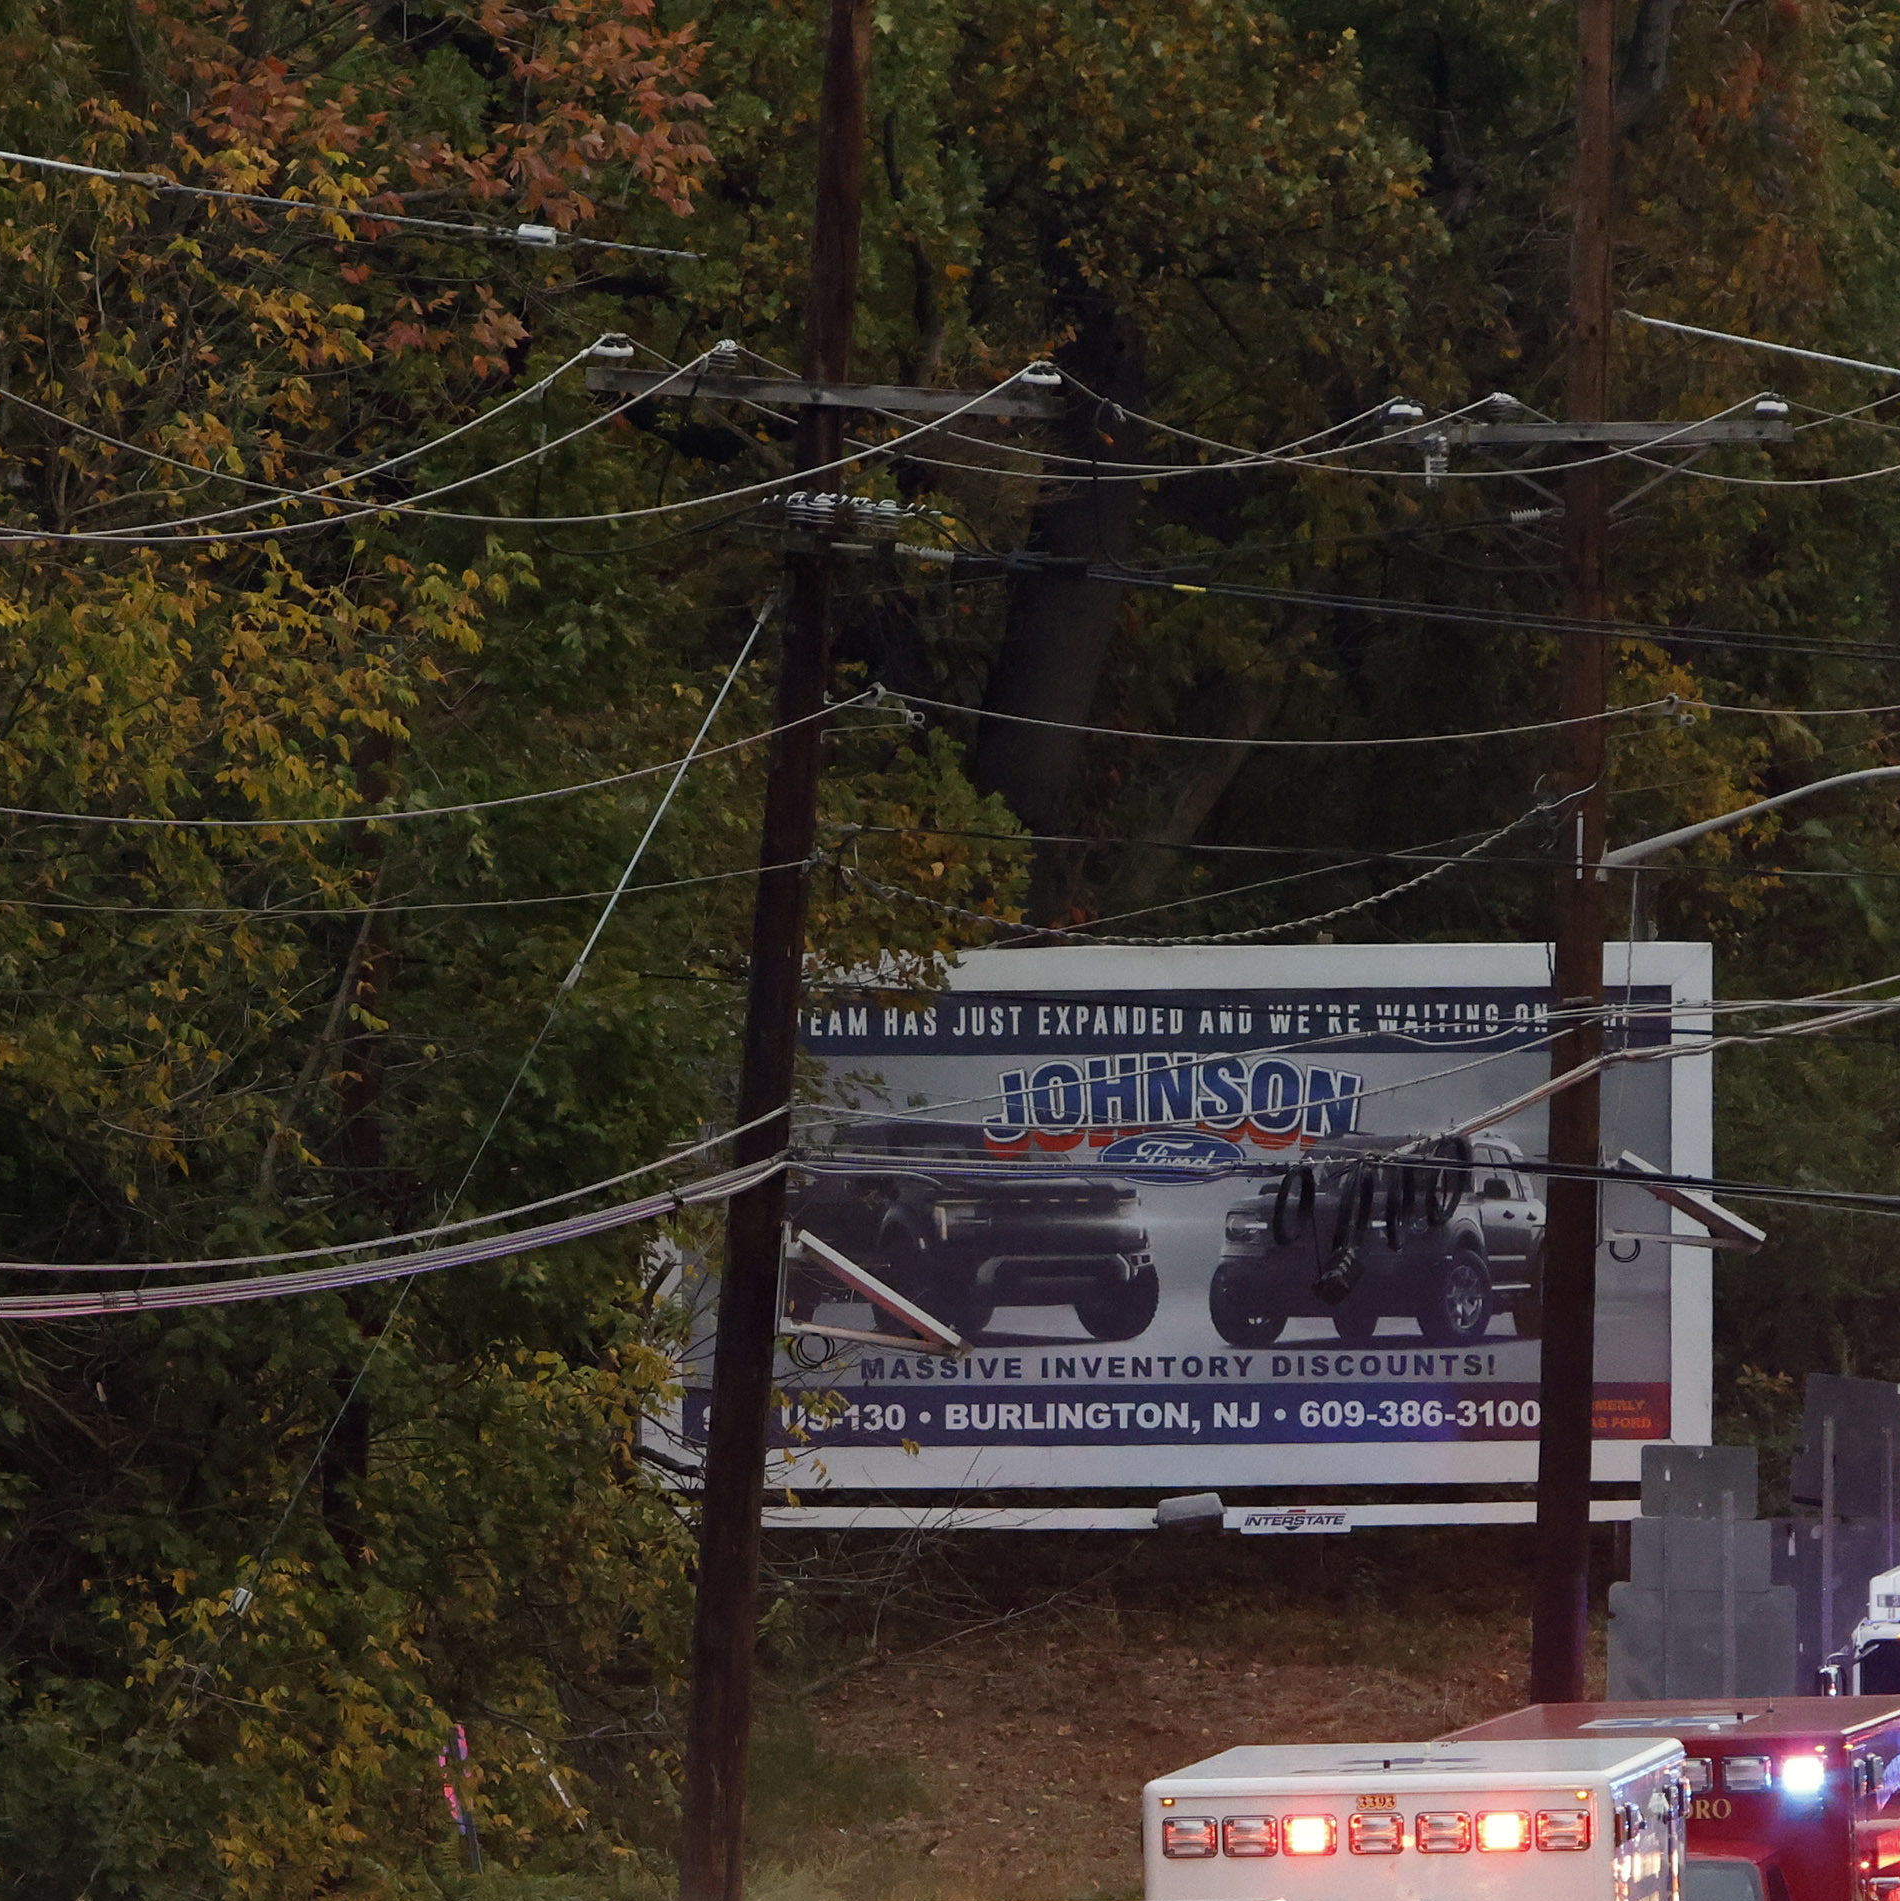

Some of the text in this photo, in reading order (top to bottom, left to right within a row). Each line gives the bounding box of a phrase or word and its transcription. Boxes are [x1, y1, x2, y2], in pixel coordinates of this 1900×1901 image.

[797, 1005, 869, 1037] EAM
[883, 1006, 938, 1037] HAS
[952, 1006, 1023, 1037] JUST
[1038, 1005, 1183, 1036] EXPANDED
[1199, 1005, 1252, 1035] AND
[1268, 1003, 1361, 1035] WE'RE
[1376, 1003, 1500, 1034] WAITING
[980, 1052, 1364, 1144] JOHNSON
[860, 1354, 1497, 1380] MASSIVE INVENTORY DISCOUNTS!
[945, 1402, 1202, 1434] BURLINGTON,
[1213, 1402, 1261, 1428] NJ
[1299, 1399, 1542, 1428] 609-386-3100
[1244, 1513, 1346, 1528] INTERSTATE
[1356, 1794, 1396, 1811] 3393
